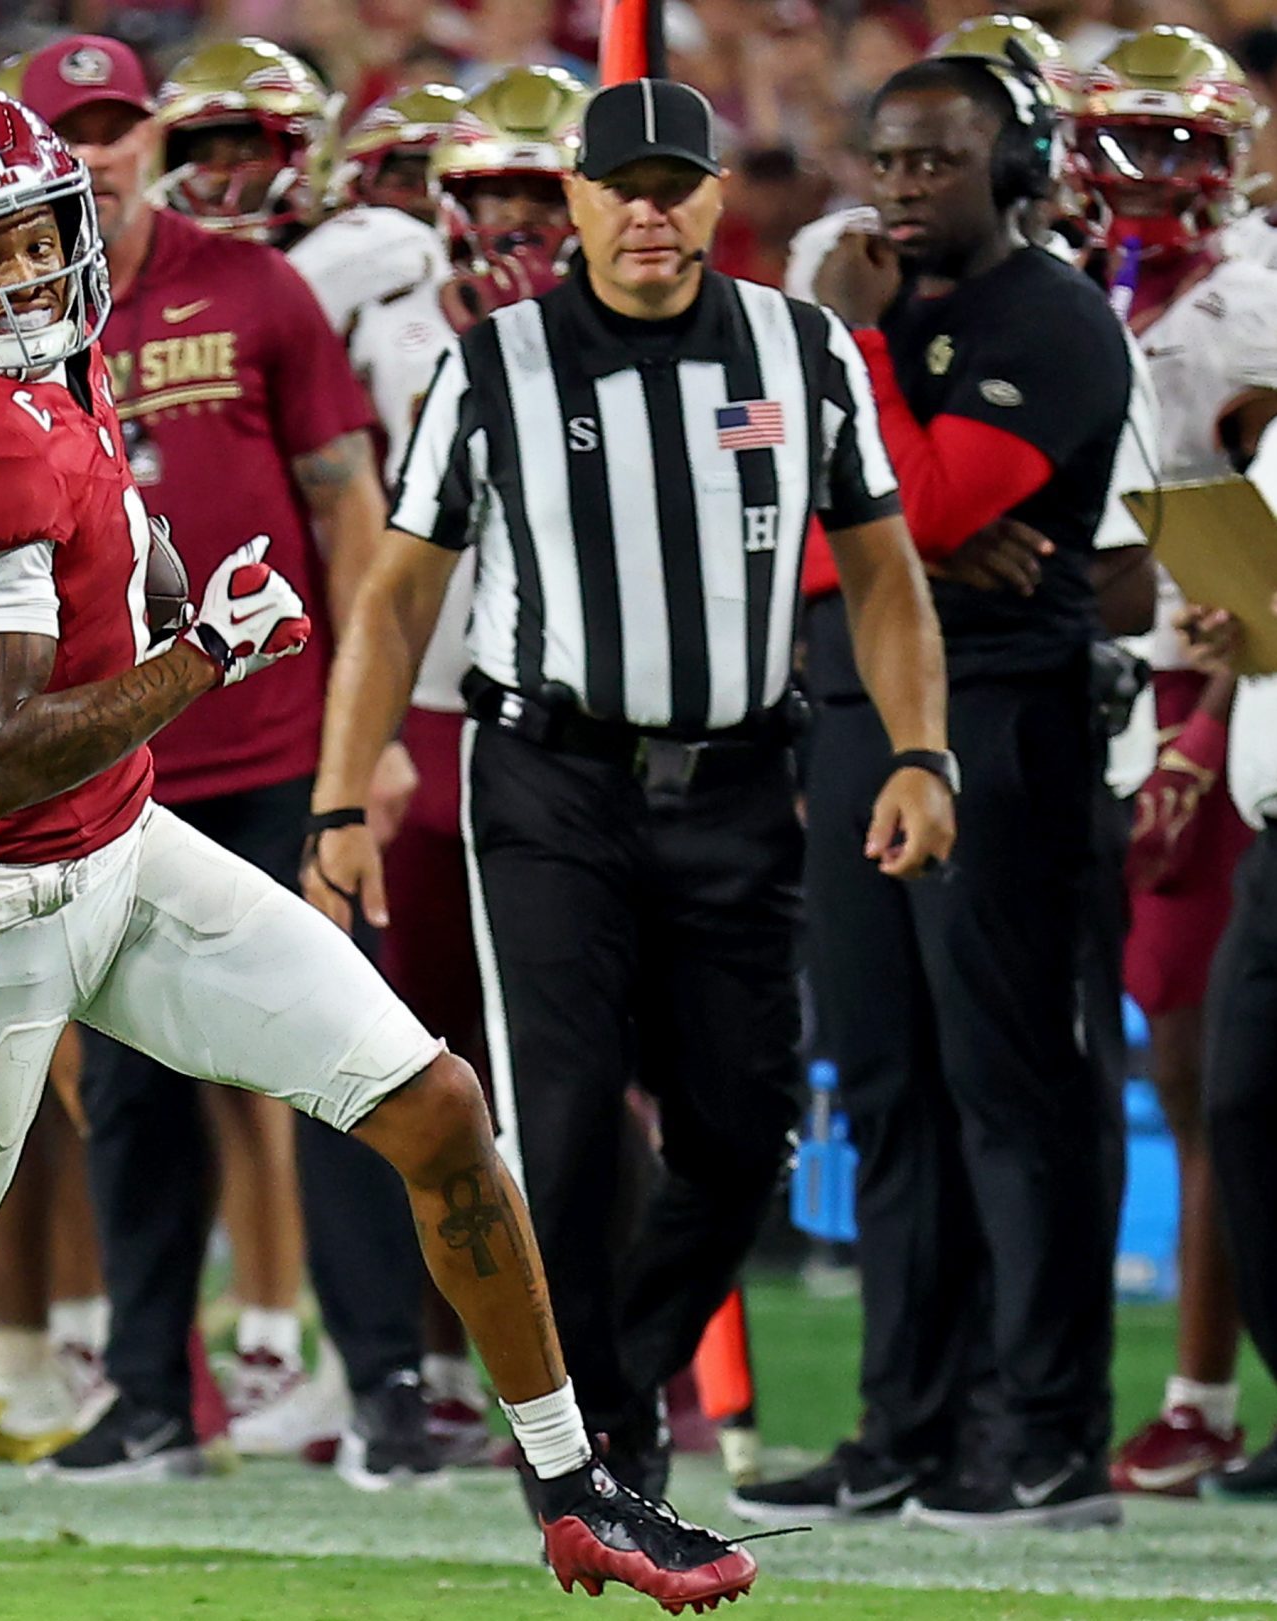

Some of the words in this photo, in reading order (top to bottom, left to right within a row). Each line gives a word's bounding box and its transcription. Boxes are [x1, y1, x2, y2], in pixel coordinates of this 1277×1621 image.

[140, 331, 238, 391] STATE
[568, 416, 600, 451] S
[744, 505, 779, 552] H
